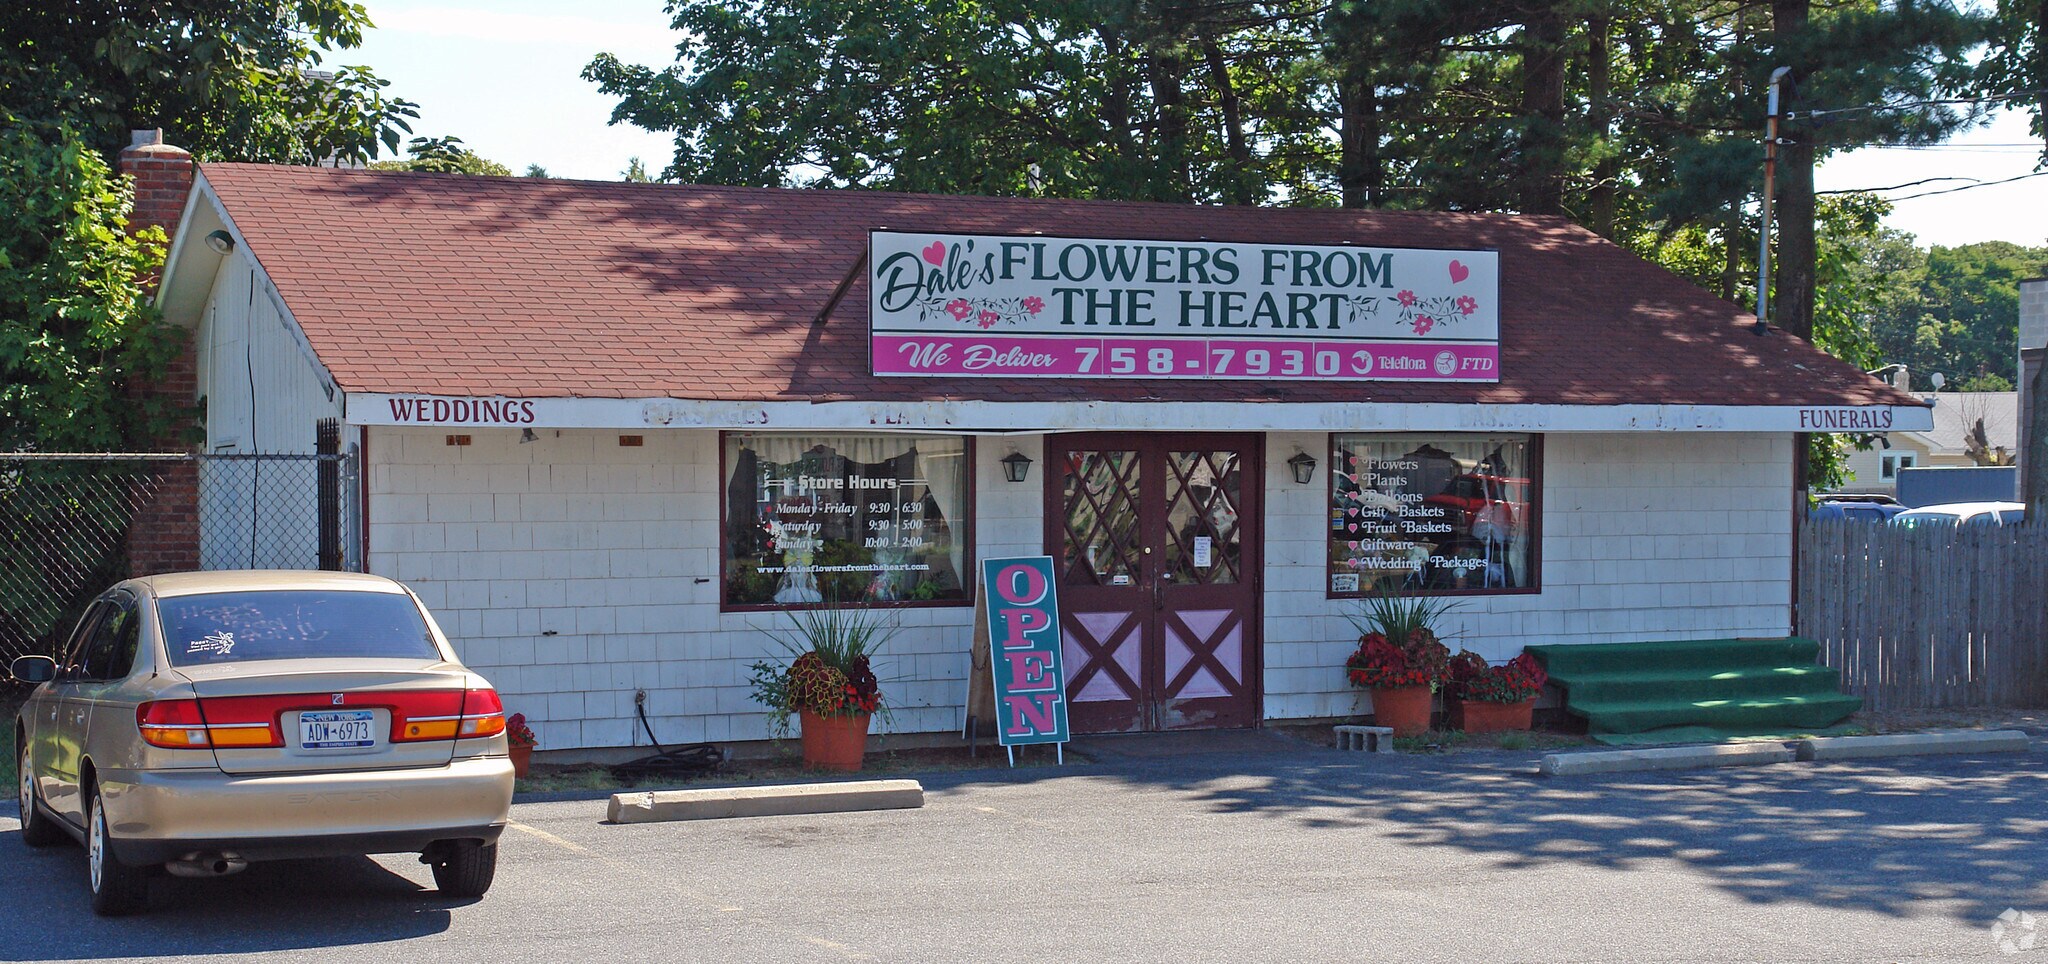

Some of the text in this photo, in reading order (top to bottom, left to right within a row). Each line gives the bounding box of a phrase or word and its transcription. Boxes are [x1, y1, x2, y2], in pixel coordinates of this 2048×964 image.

[877, 239, 1394, 313] Dale's FLOWERS FROM
[1051, 288, 1349, 329] THE HEART
[898, 342, 953, 368] We
[962, 344, 1058, 370] Deliver
[1378, 356, 1427, 370] Teleflora
[1461, 357, 1493, 371] FTD
[388, 398, 535, 424] WEDDINGS
[1799, 409, 1892, 429] FUNERALS
[1362, 458, 1419, 470] Flowers
[799, 475, 897, 489] Store Hours
[1362, 472, 1408, 486] Plants
[1361, 489, 1423, 502] Blloons
[775, 503, 817, 517] Monday
[824, 503, 858, 517] Friday
[869, 502, 891, 513] 9:30
[902, 502, 922, 513] 6:30
[1361, 505, 1445, 518] Gift Baskets
[776, 520, 822, 534] Saturday
[868, 519, 890, 530] 9:30
[901, 519, 922, 530] 5:00
[1361, 520, 1452, 534] Fruit Baskets
[775, 537, 814, 550] Sunday
[864, 537, 889, 548] 10:00
[901, 537, 922, 548] 2:00
[1361, 538, 1415, 551] Giftware
[757, 563, 930, 574] www.dalesflowersfromtheheart.com
[1360, 555, 1489, 571] Wedding Packages
[996, 563, 1062, 737] OPEN
